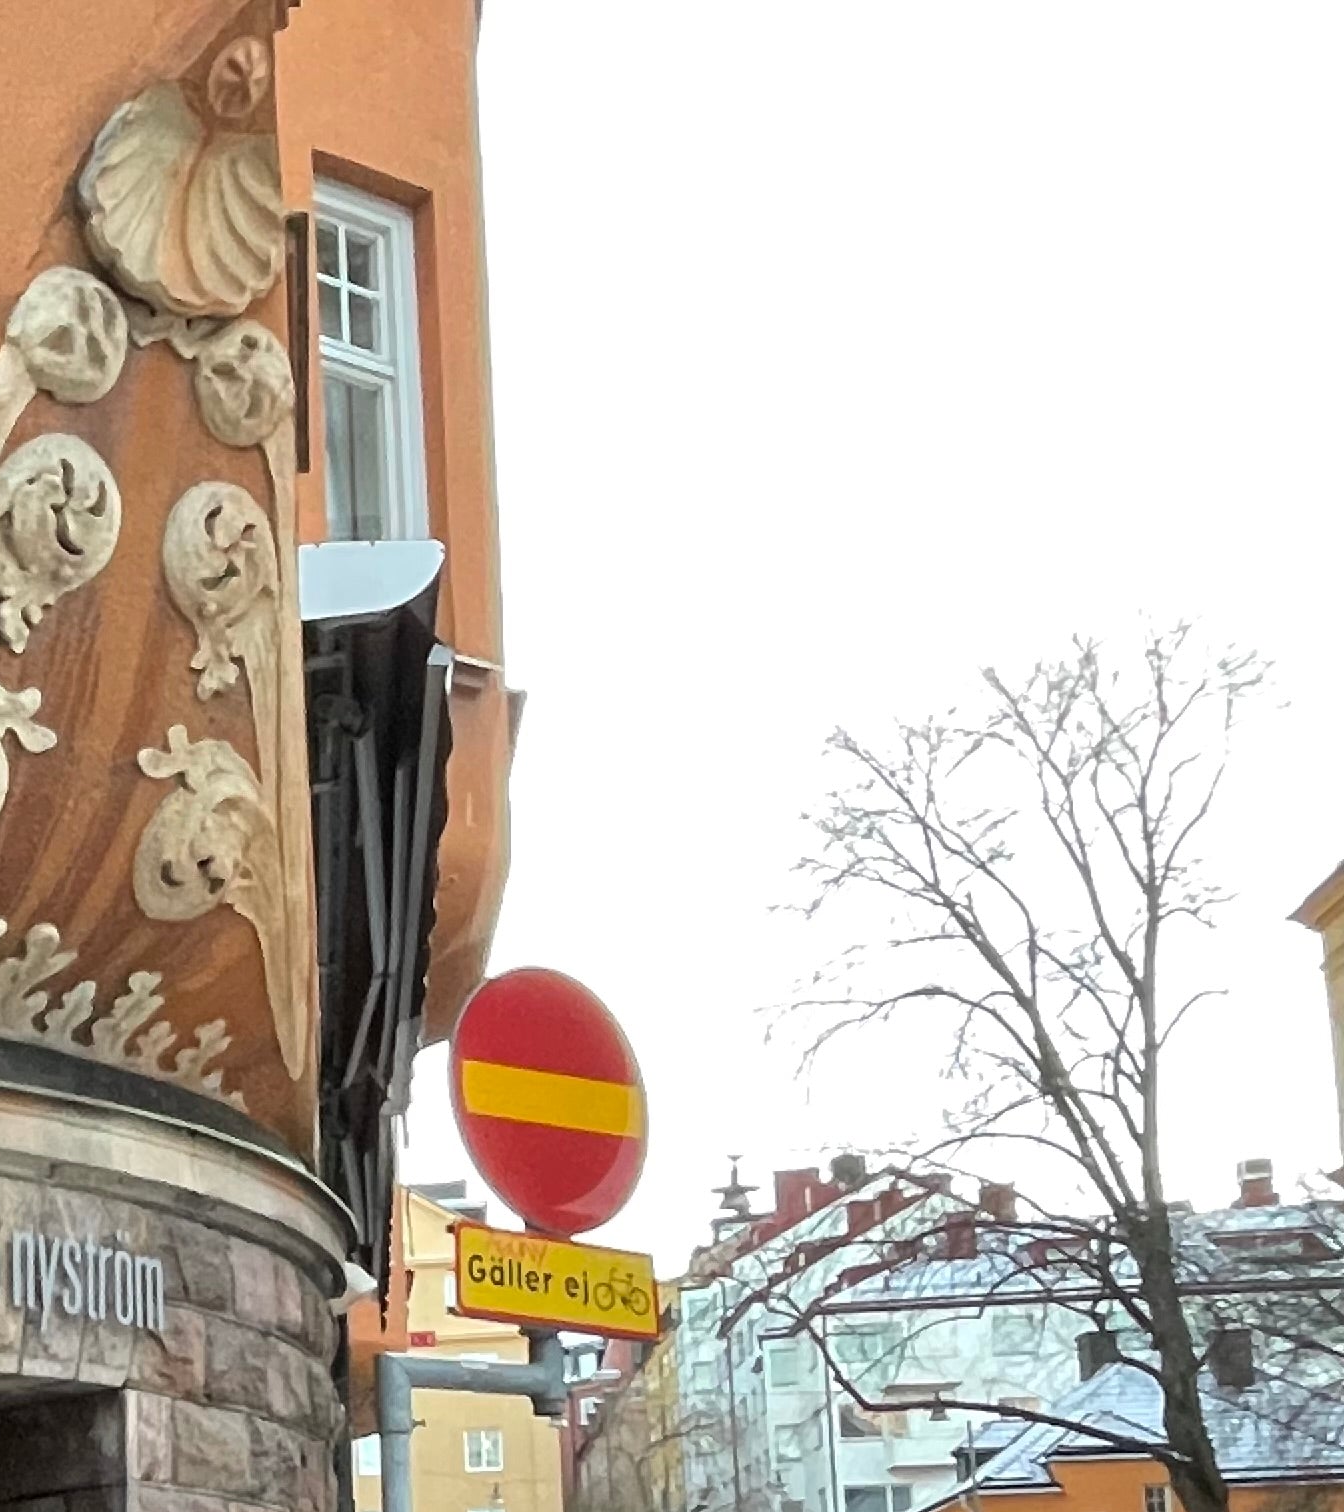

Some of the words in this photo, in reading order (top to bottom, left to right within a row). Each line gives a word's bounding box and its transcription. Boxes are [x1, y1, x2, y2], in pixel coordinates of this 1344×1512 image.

[12, 1227, 166, 1333] nyström
[467, 1254, 552, 1293] Gäller
[564, 1270, 588, 1305] ej
